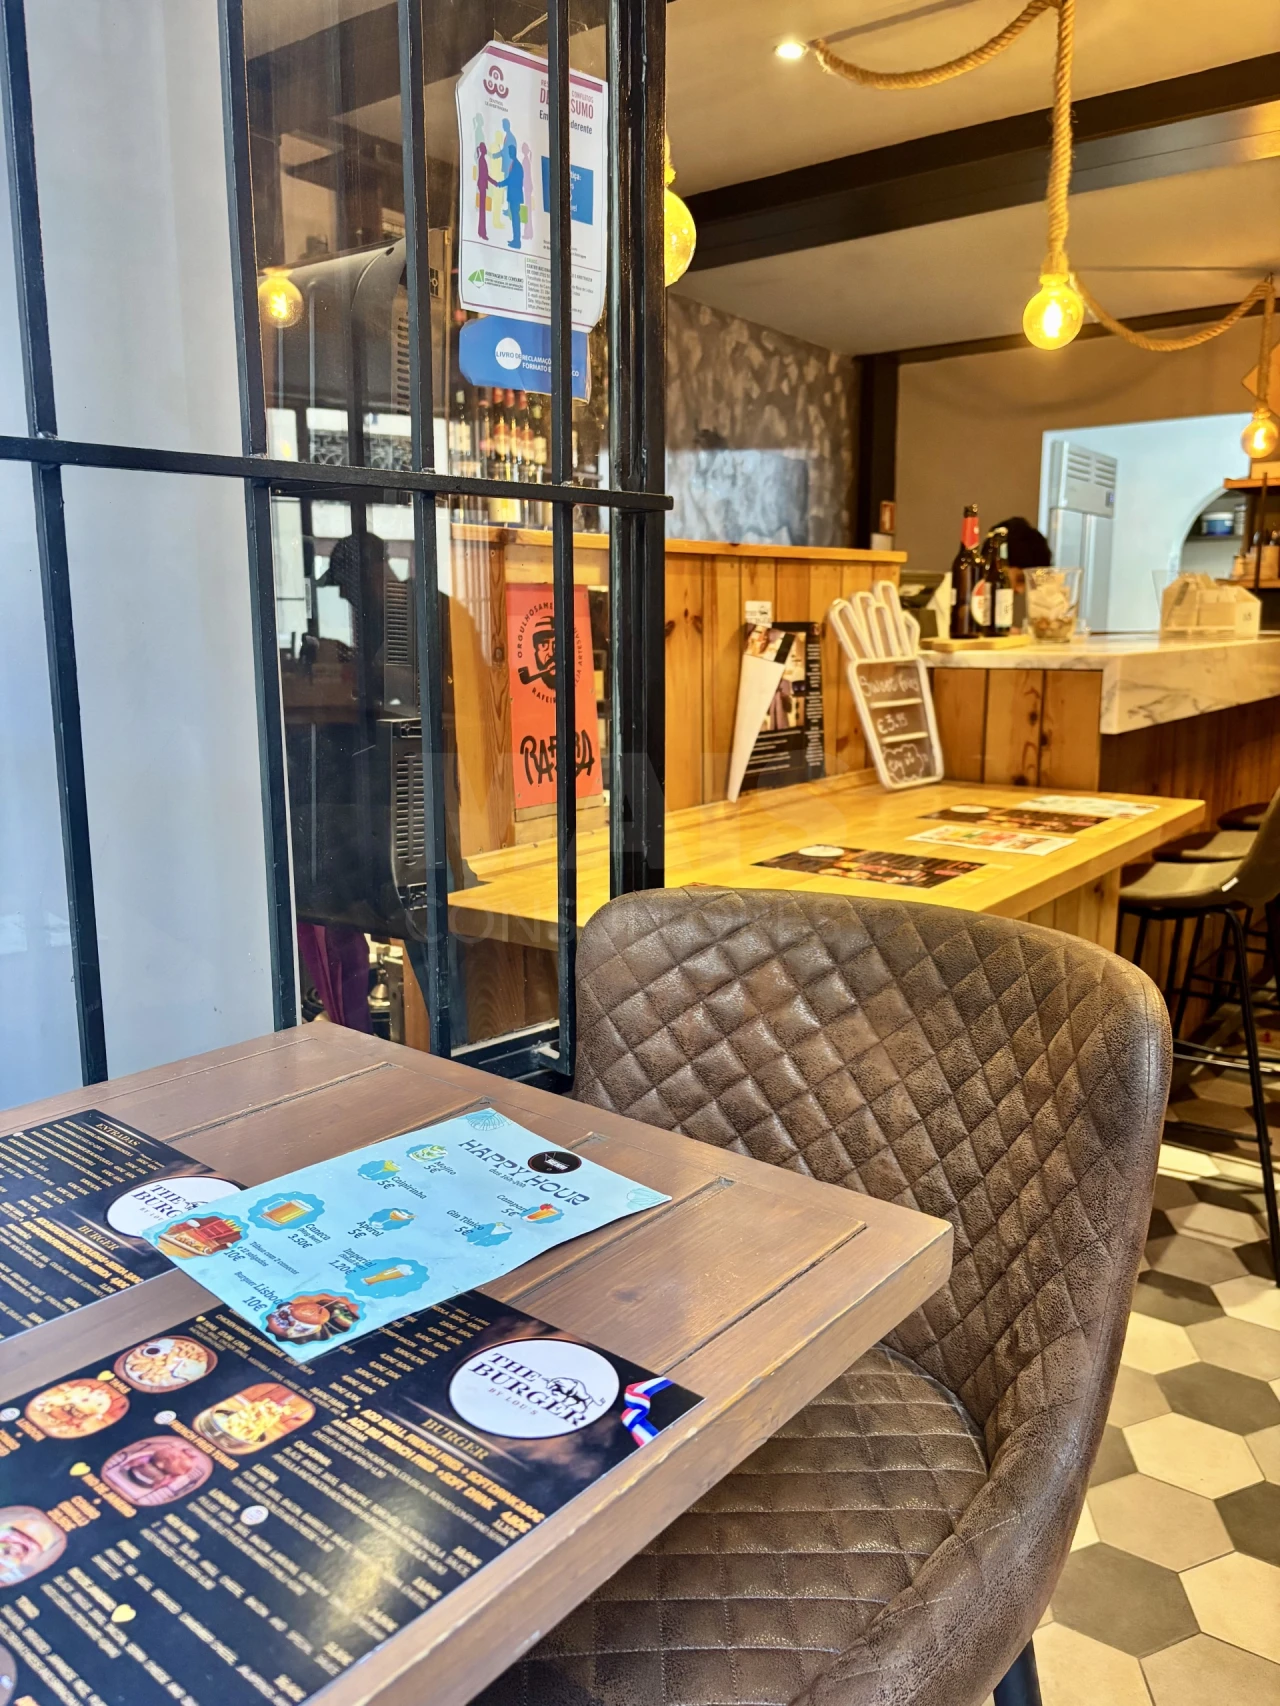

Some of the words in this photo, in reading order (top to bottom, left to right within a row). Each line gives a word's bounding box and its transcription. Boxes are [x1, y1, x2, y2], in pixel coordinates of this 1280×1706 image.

[496, 351, 514, 359] LIVRO
[522, 354, 551, 365] RECLAMAÇÕ
[95, 1123, 141, 1147] ENTRADAS
[422, 1164, 441, 1173] 5€
[431, 1161, 459, 1175] Mojito
[456, 1138, 533, 1178] HAPPY
[524, 1173, 590, 1207] HOUR
[376, 1179, 396, 1189] 5€
[387, 1175, 430, 1199] Caipirinha
[150, 1184, 186, 1205] THE
[494, 1193, 531, 1213] Campari
[131, 1190, 184, 1219] BURG
[499, 1207, 520, 1217] 5€
[444, 1209, 463, 1219] Gin
[304, 1223, 333, 1240] Caneca
[346, 1228, 367, 1239] 5€
[354, 1220, 384, 1237] Aperol
[453, 1225, 474, 1236] 5€
[78, 1226, 119, 1251] BURGER
[286, 1233, 313, 1249] 3.50€
[223, 1248, 246, 1262] 10€
[342, 1247, 376, 1268] Imperial
[328, 1258, 356, 1276] 1.20€
[252, 1282, 286, 1305] Lisboa
[241, 1295, 268, 1312] 10€
[488, 1352, 542, 1383] THE
[468, 1362, 587, 1427] BURGER
[488, 1388, 502, 1397] BY
[359, 1408, 384, 1423] ADD
[377, 1417, 410, 1438] SMALL
[402, 1432, 442, 1457] FRENCH
[420, 1417, 491, 1460] BURGER
[345, 1415, 371, 1431] ADD
[377, 1434, 416, 1459] FRENCH
[461, 1485, 499, 1510] DRINK
